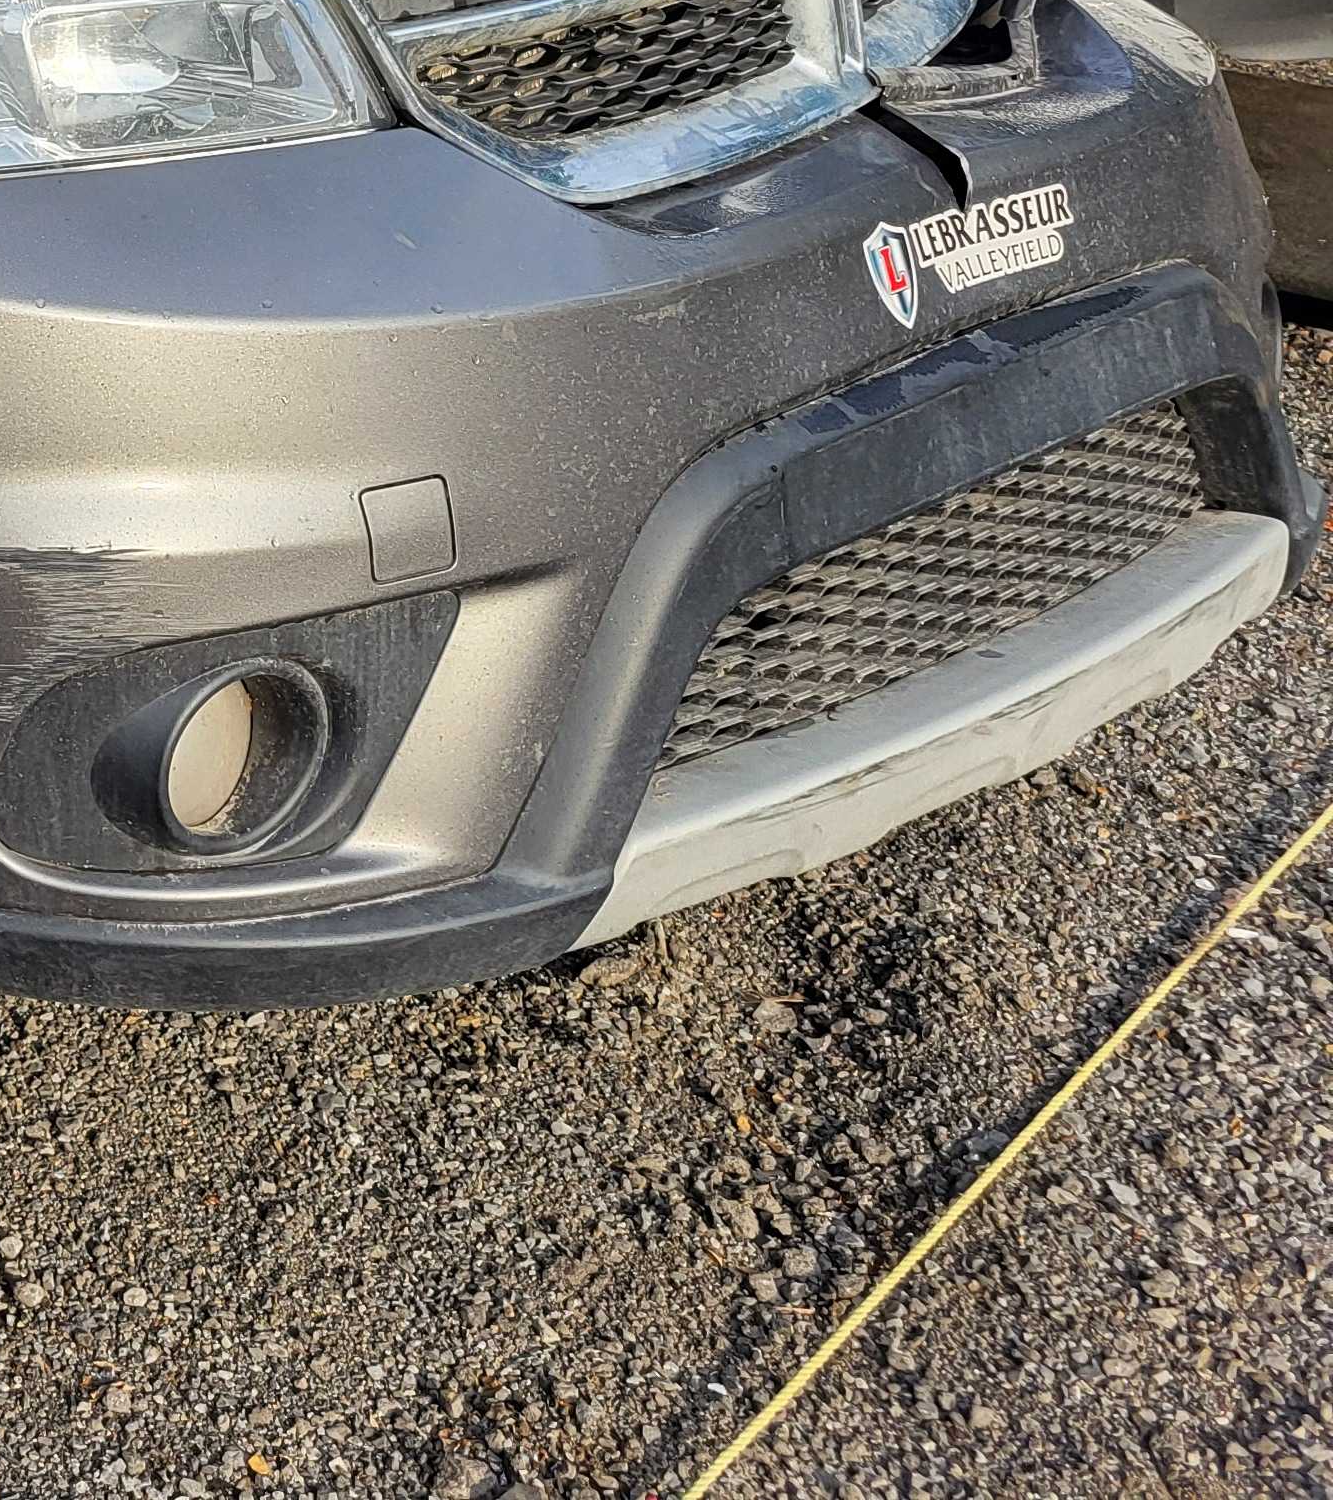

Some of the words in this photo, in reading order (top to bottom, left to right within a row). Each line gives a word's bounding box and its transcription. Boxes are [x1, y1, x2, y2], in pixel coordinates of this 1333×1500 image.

[911, 188, 1071, 262] LEBRASSEUR
[879, 245, 907, 293] L
[940, 234, 1062, 288] VALLEYFIELD
